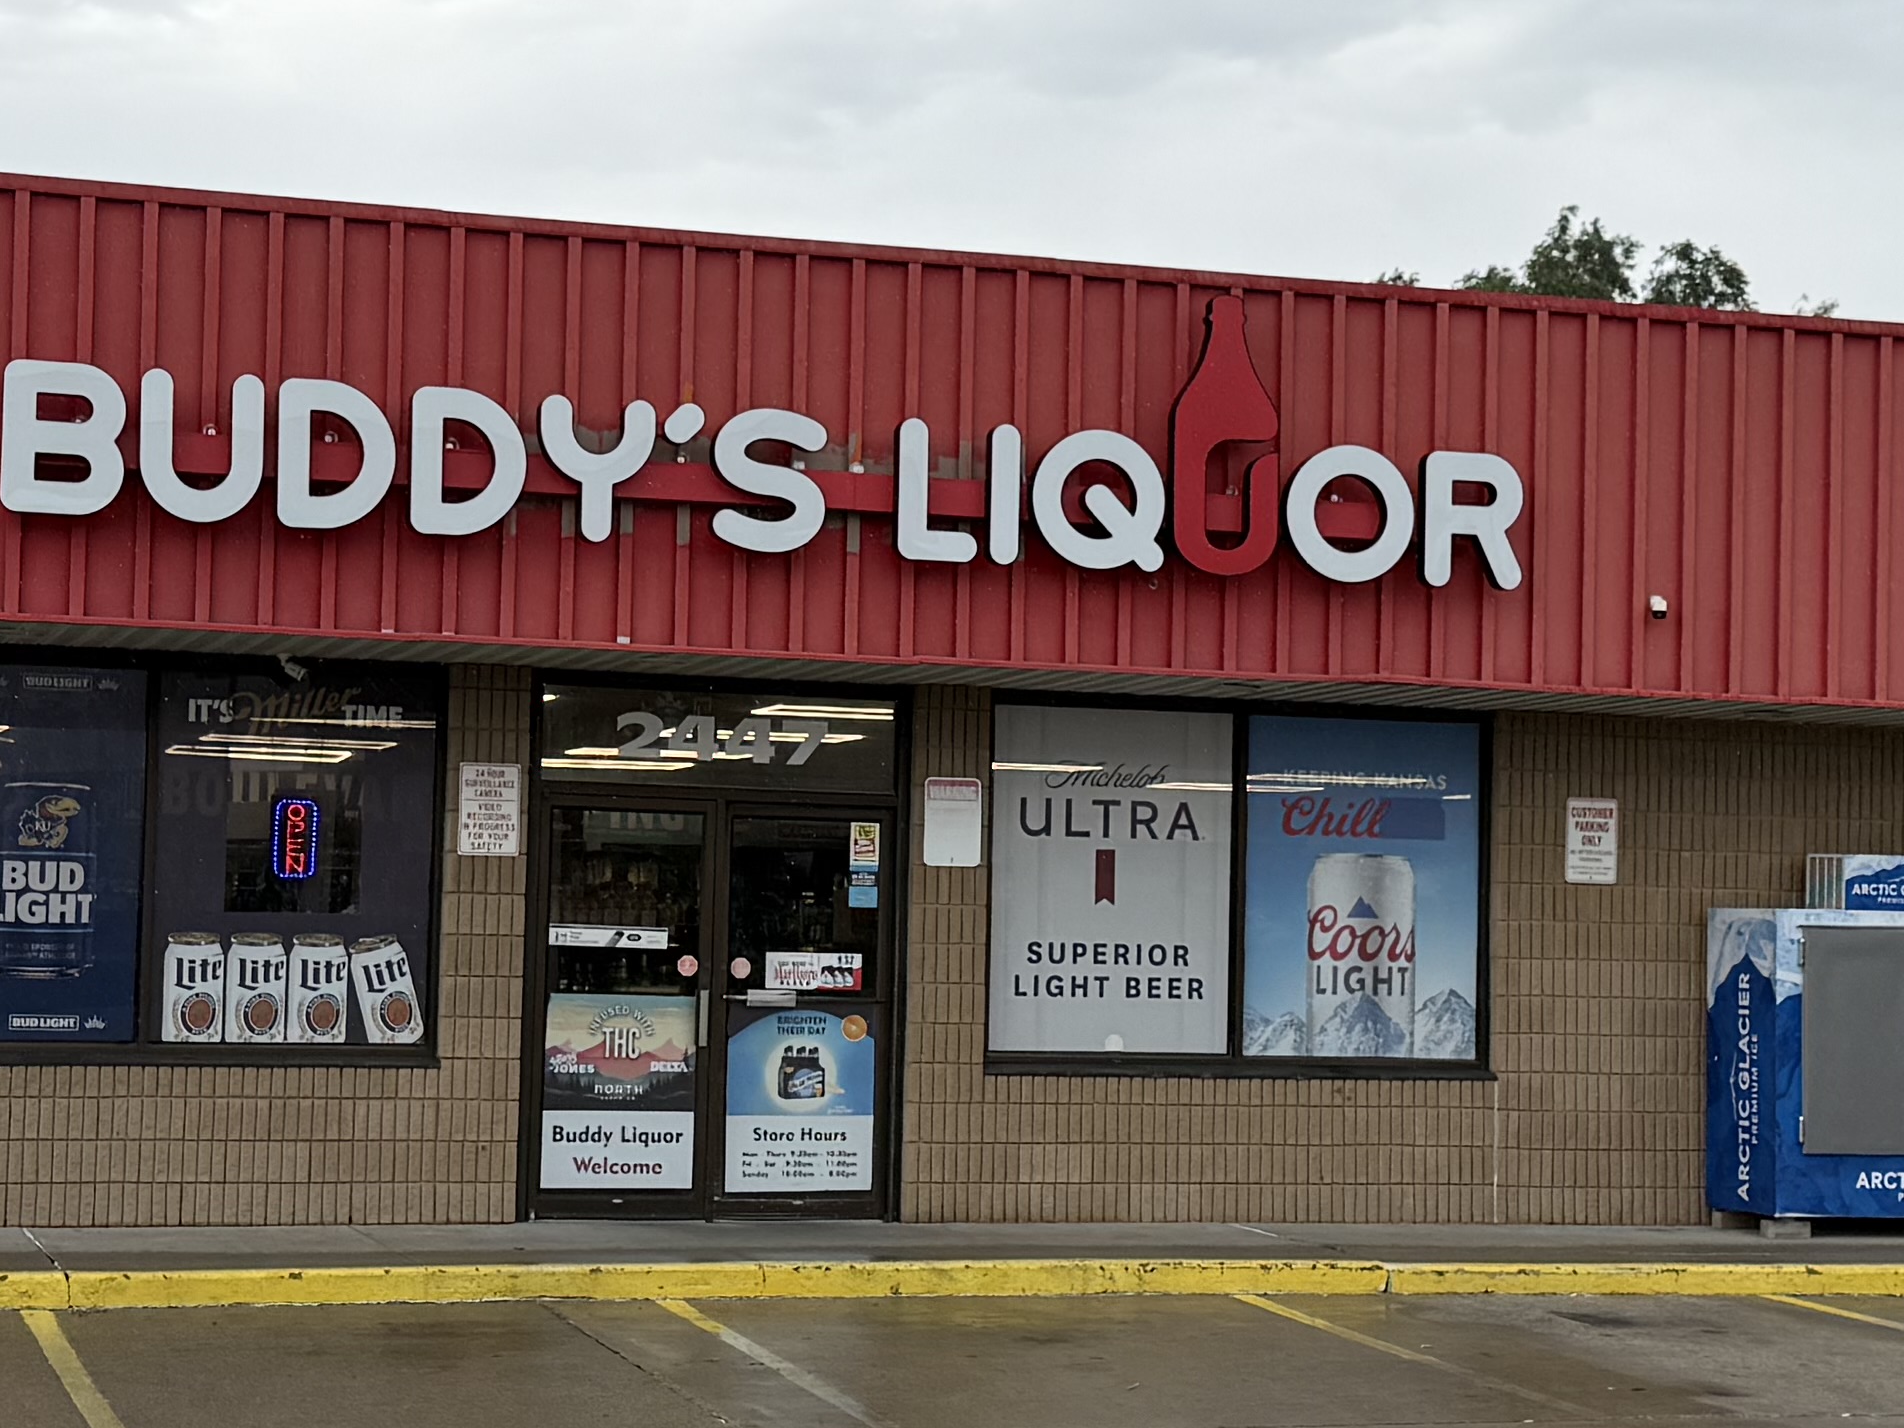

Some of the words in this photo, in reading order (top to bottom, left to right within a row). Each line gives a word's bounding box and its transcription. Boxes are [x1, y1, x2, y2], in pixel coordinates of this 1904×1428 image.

[0, 357, 829, 555] BUDDY'S
[896, 332, 1525, 591] LIQUOR
[188, 698, 233, 723] IT'S
[231, 686, 362, 736] Miller
[341, 704, 404, 728] TIME
[617, 710, 829, 765] 2447
[1045, 760, 1170, 789] Michelob
[1374, 772, 1447, 791] KANSAS
[1020, 797, 1200, 841] ULTRA
[1281, 795, 1392, 839] Chill
[285, 804, 305, 876] OPEN
[2, 860, 85, 892] BUD
[1851, 883, 1898, 896] ARCTIC
[1307, 904, 1416, 963] Coors
[1026, 941, 1189, 967] SUPERIOR
[175, 957, 222, 991] Lite
[237, 957, 284, 991] Lite
[299, 958, 346, 992] Lite
[361, 957, 407, 993] Lite
[1014, 974, 1110, 998] LIGHT
[1125, 976, 1204, 1000] BEER
[1315, 964, 1410, 997] LIGHT
[589, 1004, 630, 1037] INFUSED
[633, 1008, 657, 1038] WITH
[1737, 972, 1750, 1091] GLACIER
[602, 1027, 641, 1059] THC
[1751, 1033, 1759, 1060] ICE
[1751, 1067, 1759, 1145] PREMIUM
[552, 1125, 613, 1148] Buddy
[621, 1125, 684, 1148] Liquor
[1737, 1099, 1750, 1202] ARCTIC
[572, 1156, 663, 1175] Welcome
